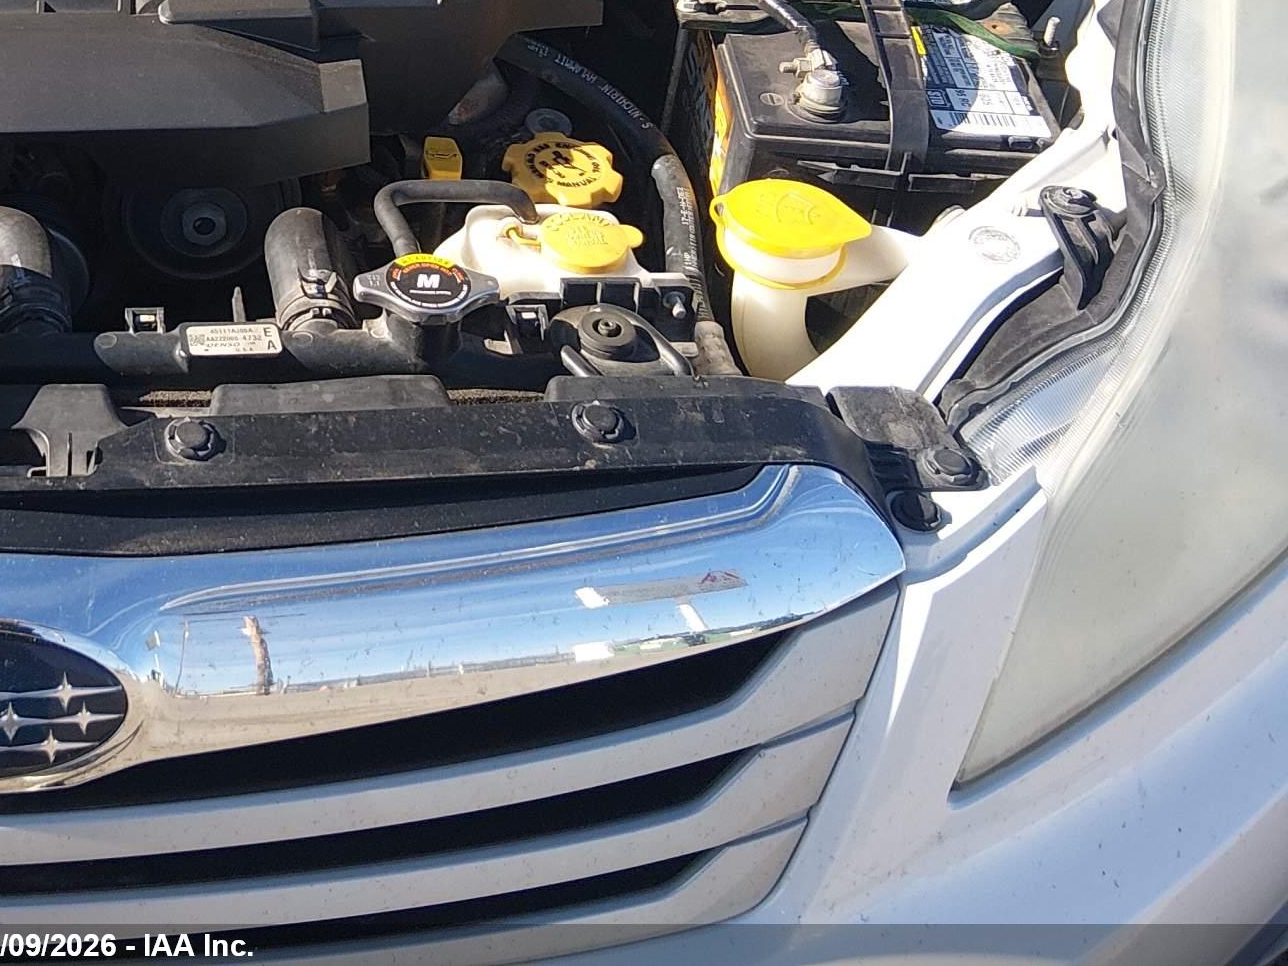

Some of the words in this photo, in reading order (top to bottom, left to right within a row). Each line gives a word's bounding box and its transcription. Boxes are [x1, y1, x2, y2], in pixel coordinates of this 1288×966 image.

[417, 274, 440, 288] M
[263, 327, 272, 337] E
[267, 339, 277, 351] A
